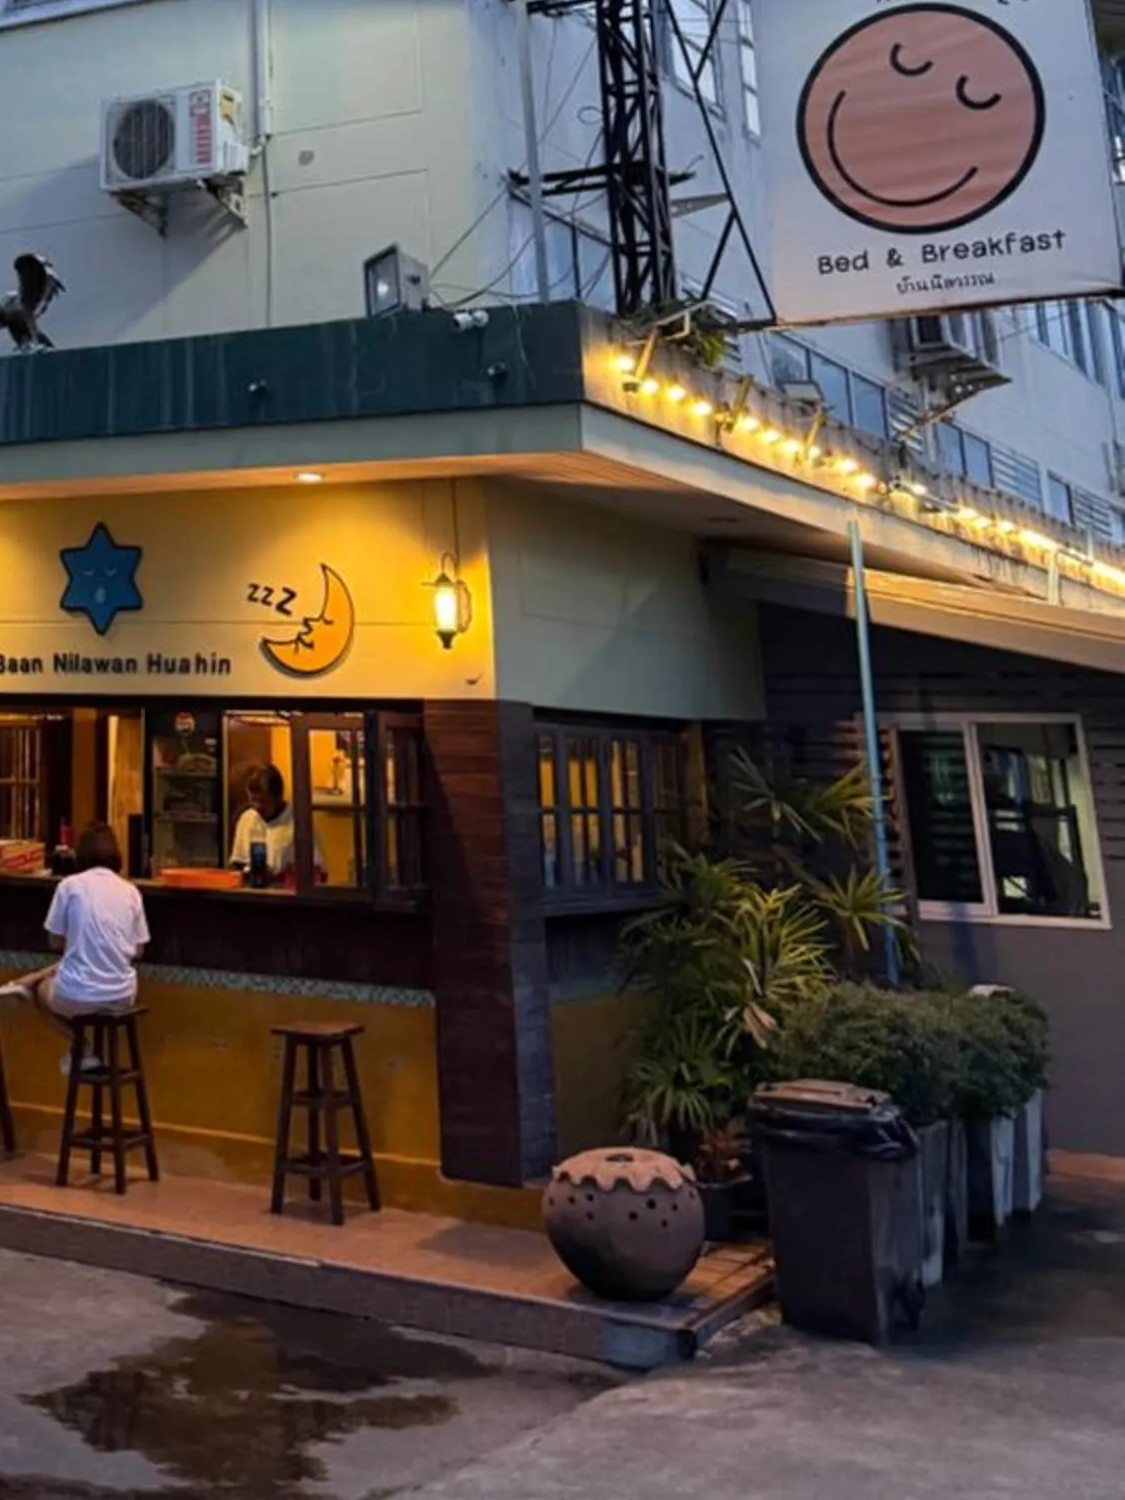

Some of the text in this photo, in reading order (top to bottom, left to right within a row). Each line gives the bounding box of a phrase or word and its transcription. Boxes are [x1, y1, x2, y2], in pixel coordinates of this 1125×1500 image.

[817, 229, 1066, 275] Bed & Breakfast
[53, 653, 137, 675] Nilawan
[146, 653, 232, 676] Huahin
